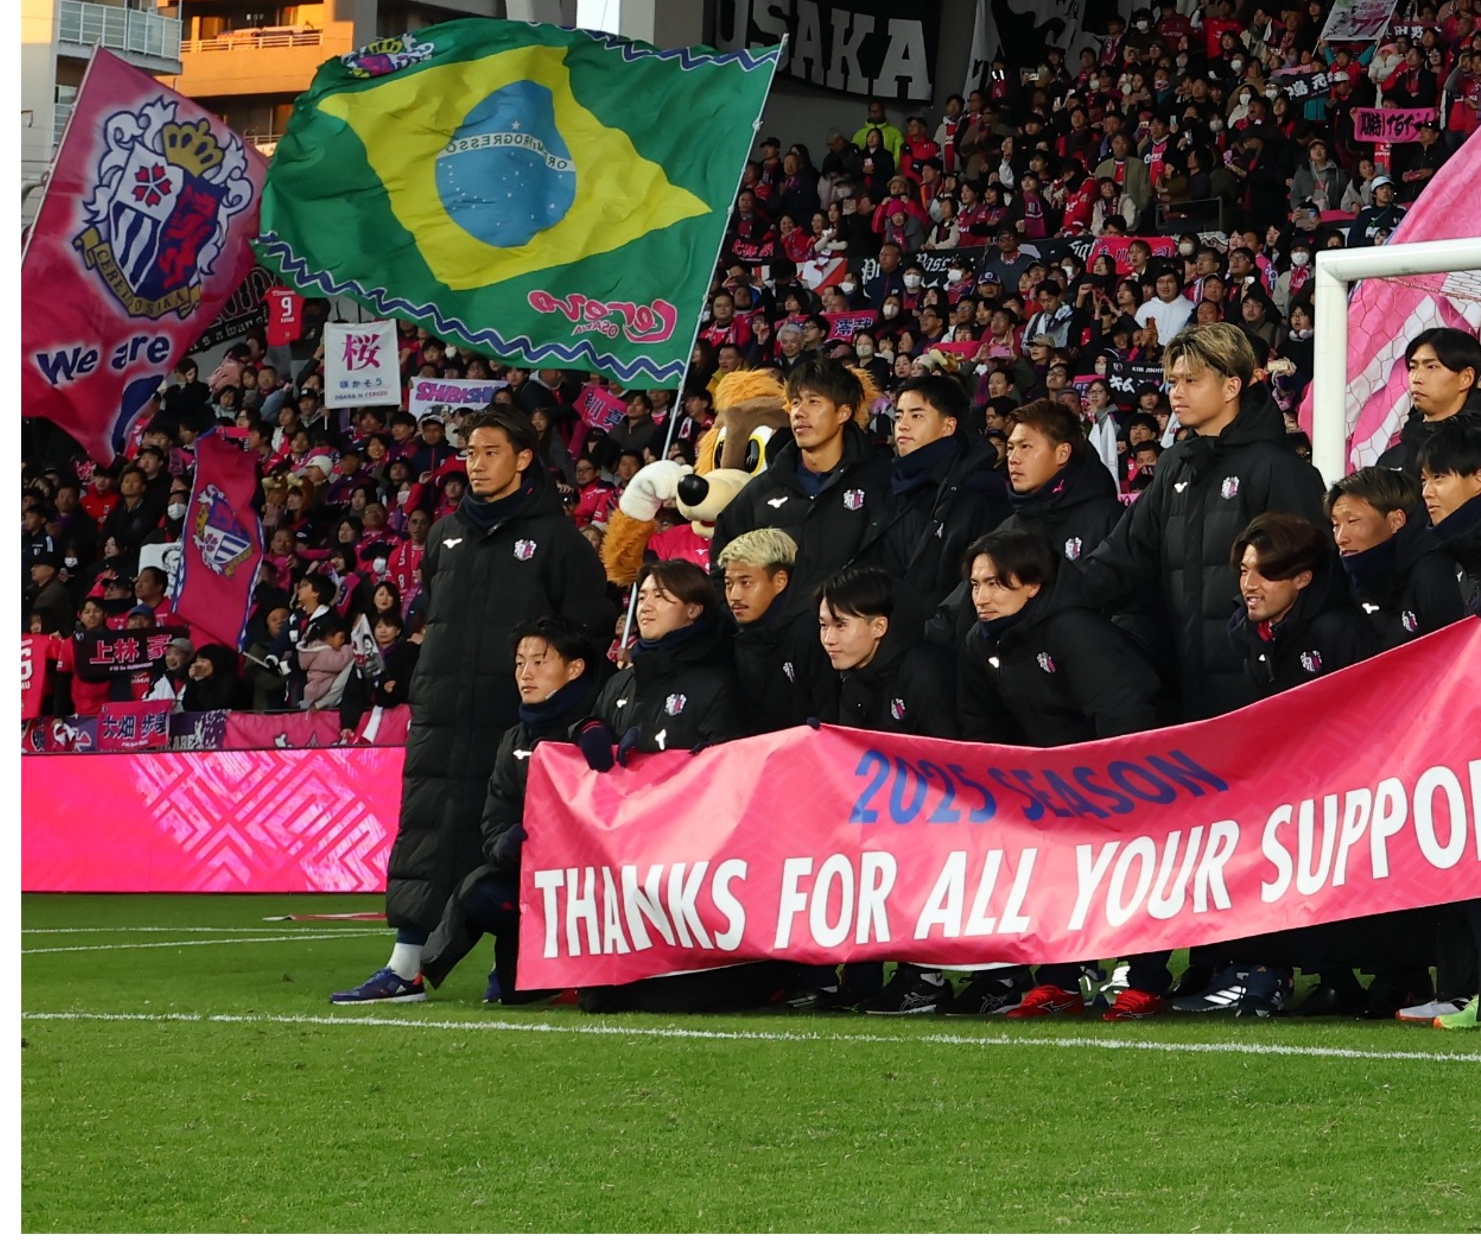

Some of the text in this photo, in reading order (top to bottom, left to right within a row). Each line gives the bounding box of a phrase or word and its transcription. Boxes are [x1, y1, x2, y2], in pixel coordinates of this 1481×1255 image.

[280, 296, 293, 317] 9
[35, 334, 170, 385] We are
[341, 333, 382, 372] 桜
[848, 748, 1231, 826] 2025 SEASON
[533, 856, 749, 959] THANKS
[773, 852, 898, 951] FOR
[913, 846, 1034, 941] ALL
[1067, 817, 1243, 933] YOUR
